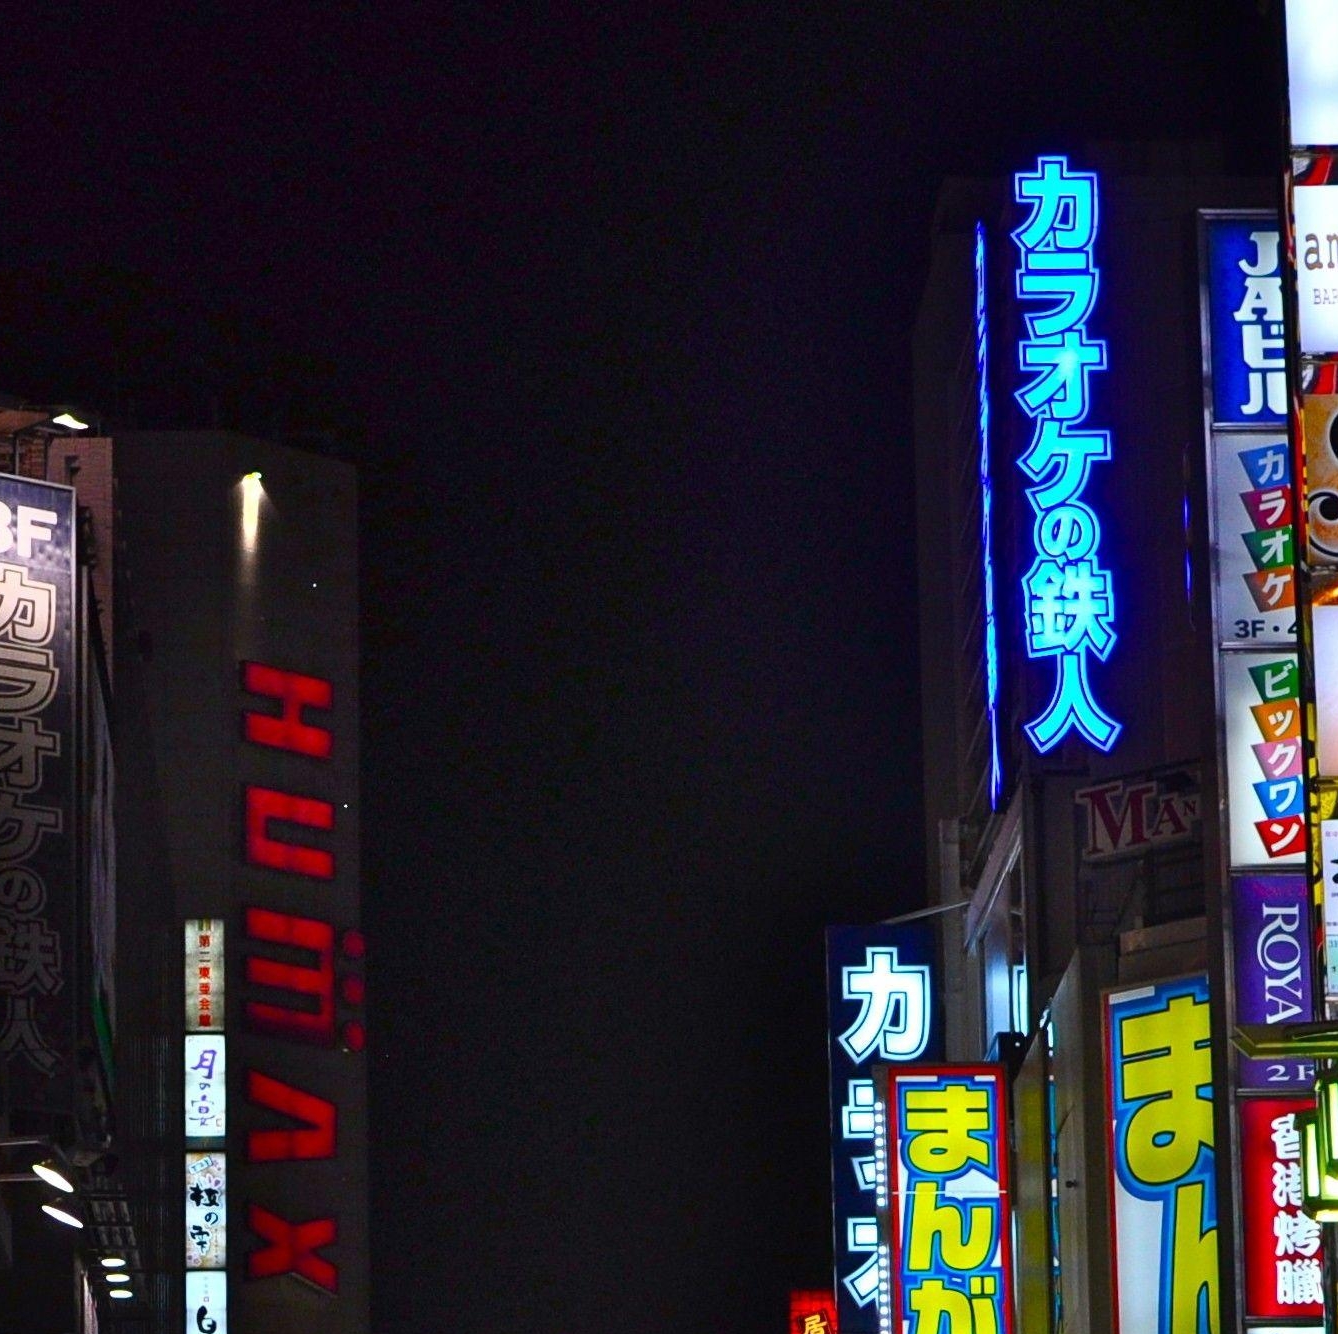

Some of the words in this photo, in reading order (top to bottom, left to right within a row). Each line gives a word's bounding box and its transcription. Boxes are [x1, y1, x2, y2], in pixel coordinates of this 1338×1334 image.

[1012, 155, 1122, 754] カラオケの鉄人
[1255, 447, 1294, 611] カラオケ
[1263, 664, 1298, 851] ビックワン
